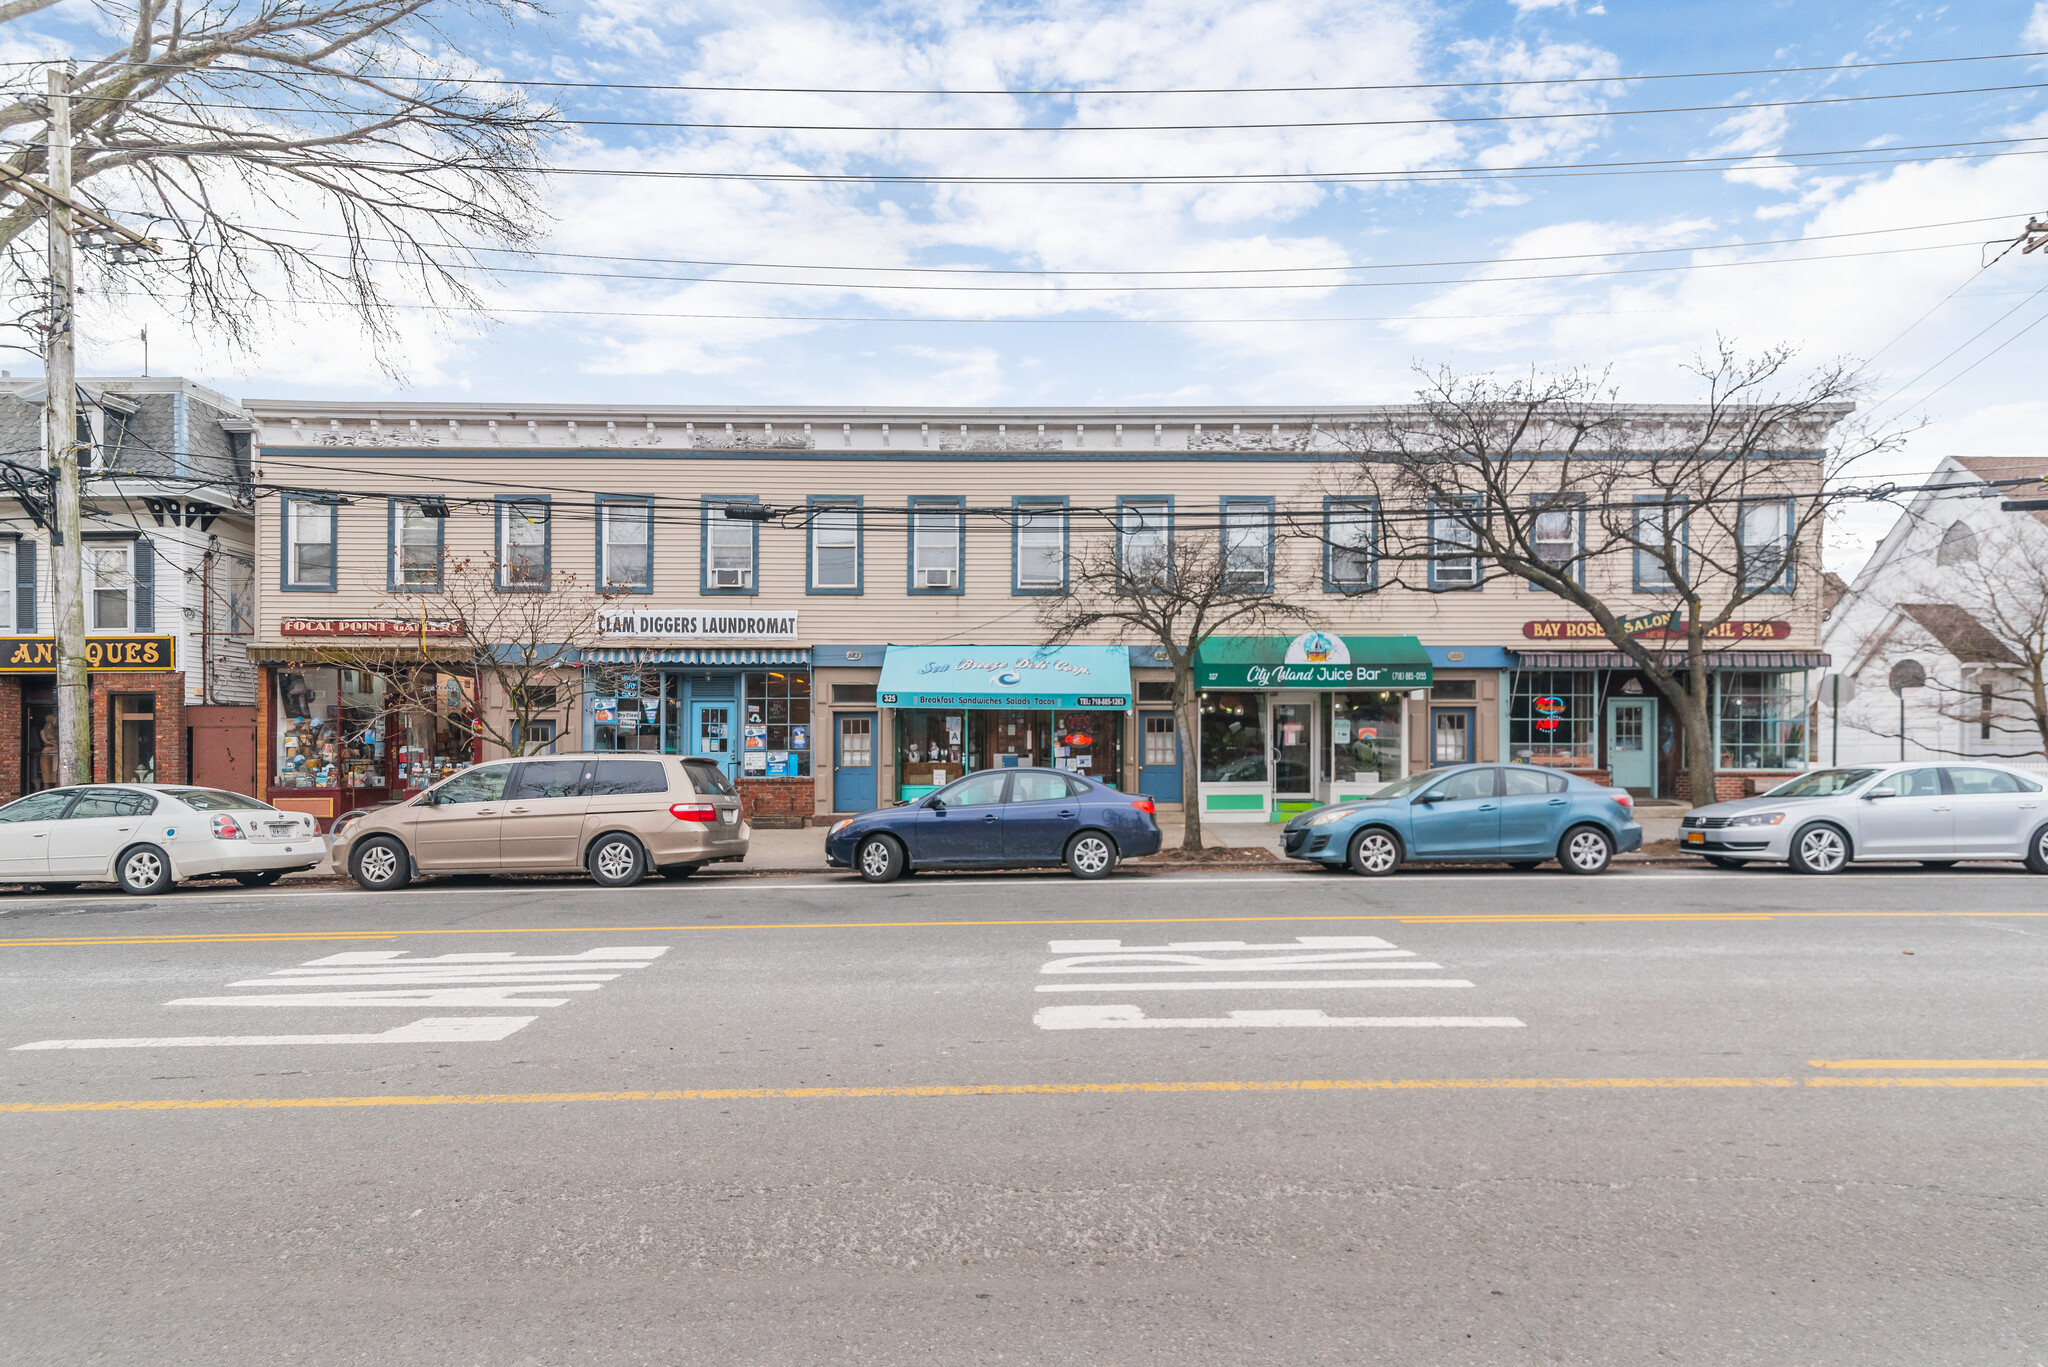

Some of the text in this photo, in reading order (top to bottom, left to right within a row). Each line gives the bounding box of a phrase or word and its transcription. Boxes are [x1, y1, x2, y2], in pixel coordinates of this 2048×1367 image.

[284, 621, 334, 631] FOCAL
[338, 621, 388, 632] POINT
[640, 617, 697, 633] DIGGERS
[702, 617, 796, 634] LAUNDROMAT
[1533, 623, 1561, 637] BAY
[1698, 622, 1736, 637] AIL
[1741, 622, 1775, 637] SPA
[1623, 612, 1671, 634] SALON
[10, 642, 160, 667] ANQUES
[918, 661, 950, 674] Sea
[1012, 658, 1050, 669] Deli
[1054, 660, 1091, 676] Corp.
[1246, 665, 1271, 686] City
[1271, 665, 1315, 683] Island
[1316, 667, 1353, 681] Juice
[1391, 672, 1405, 681] (718)
[883, 694, 896, 702] 325
[920, 696, 955, 704] Breakfast
[958, 696, 1002, 705] Sandwiches
[1005, 697, 1031, 705] Salads
[951, 732, 959, 740] A
